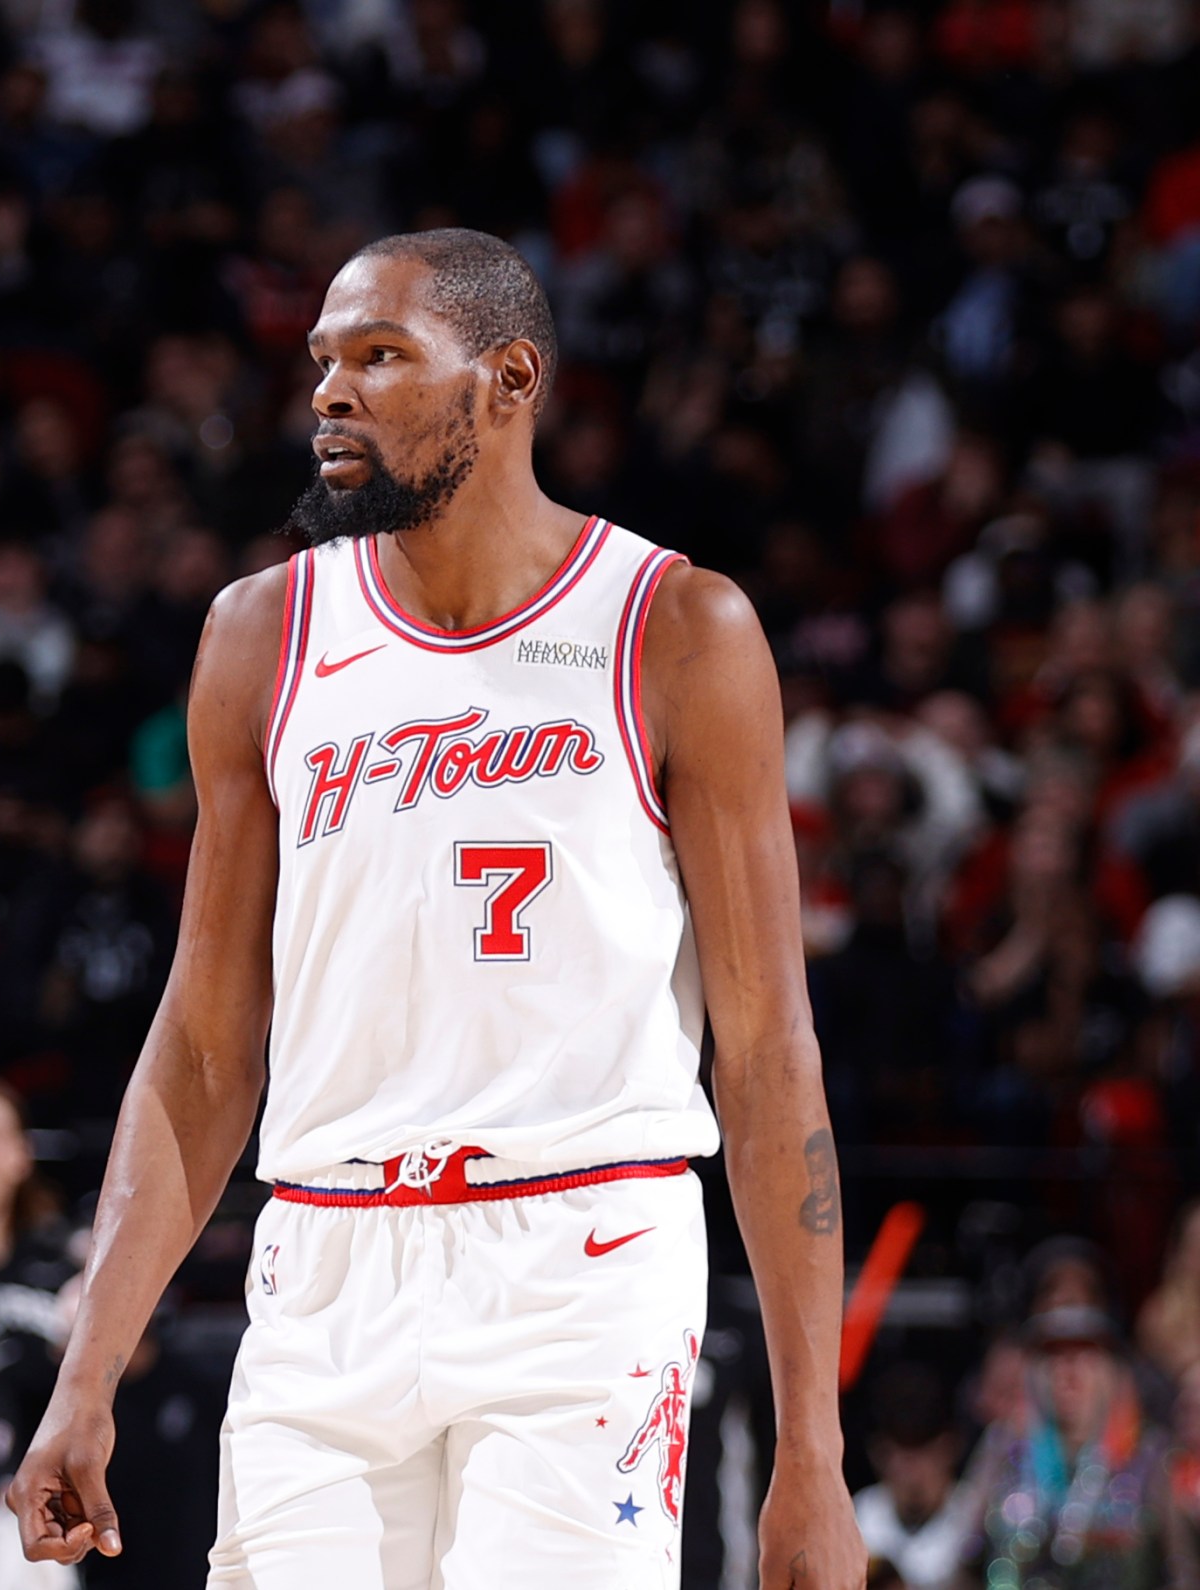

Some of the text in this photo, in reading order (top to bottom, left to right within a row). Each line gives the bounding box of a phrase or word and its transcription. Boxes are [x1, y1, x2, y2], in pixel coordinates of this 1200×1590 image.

[517, 649, 608, 670] HERMANN
[518, 639, 608, 659] MEMORIAL
[297, 706, 605, 849] H-Town
[453, 841, 553, 962] 7
